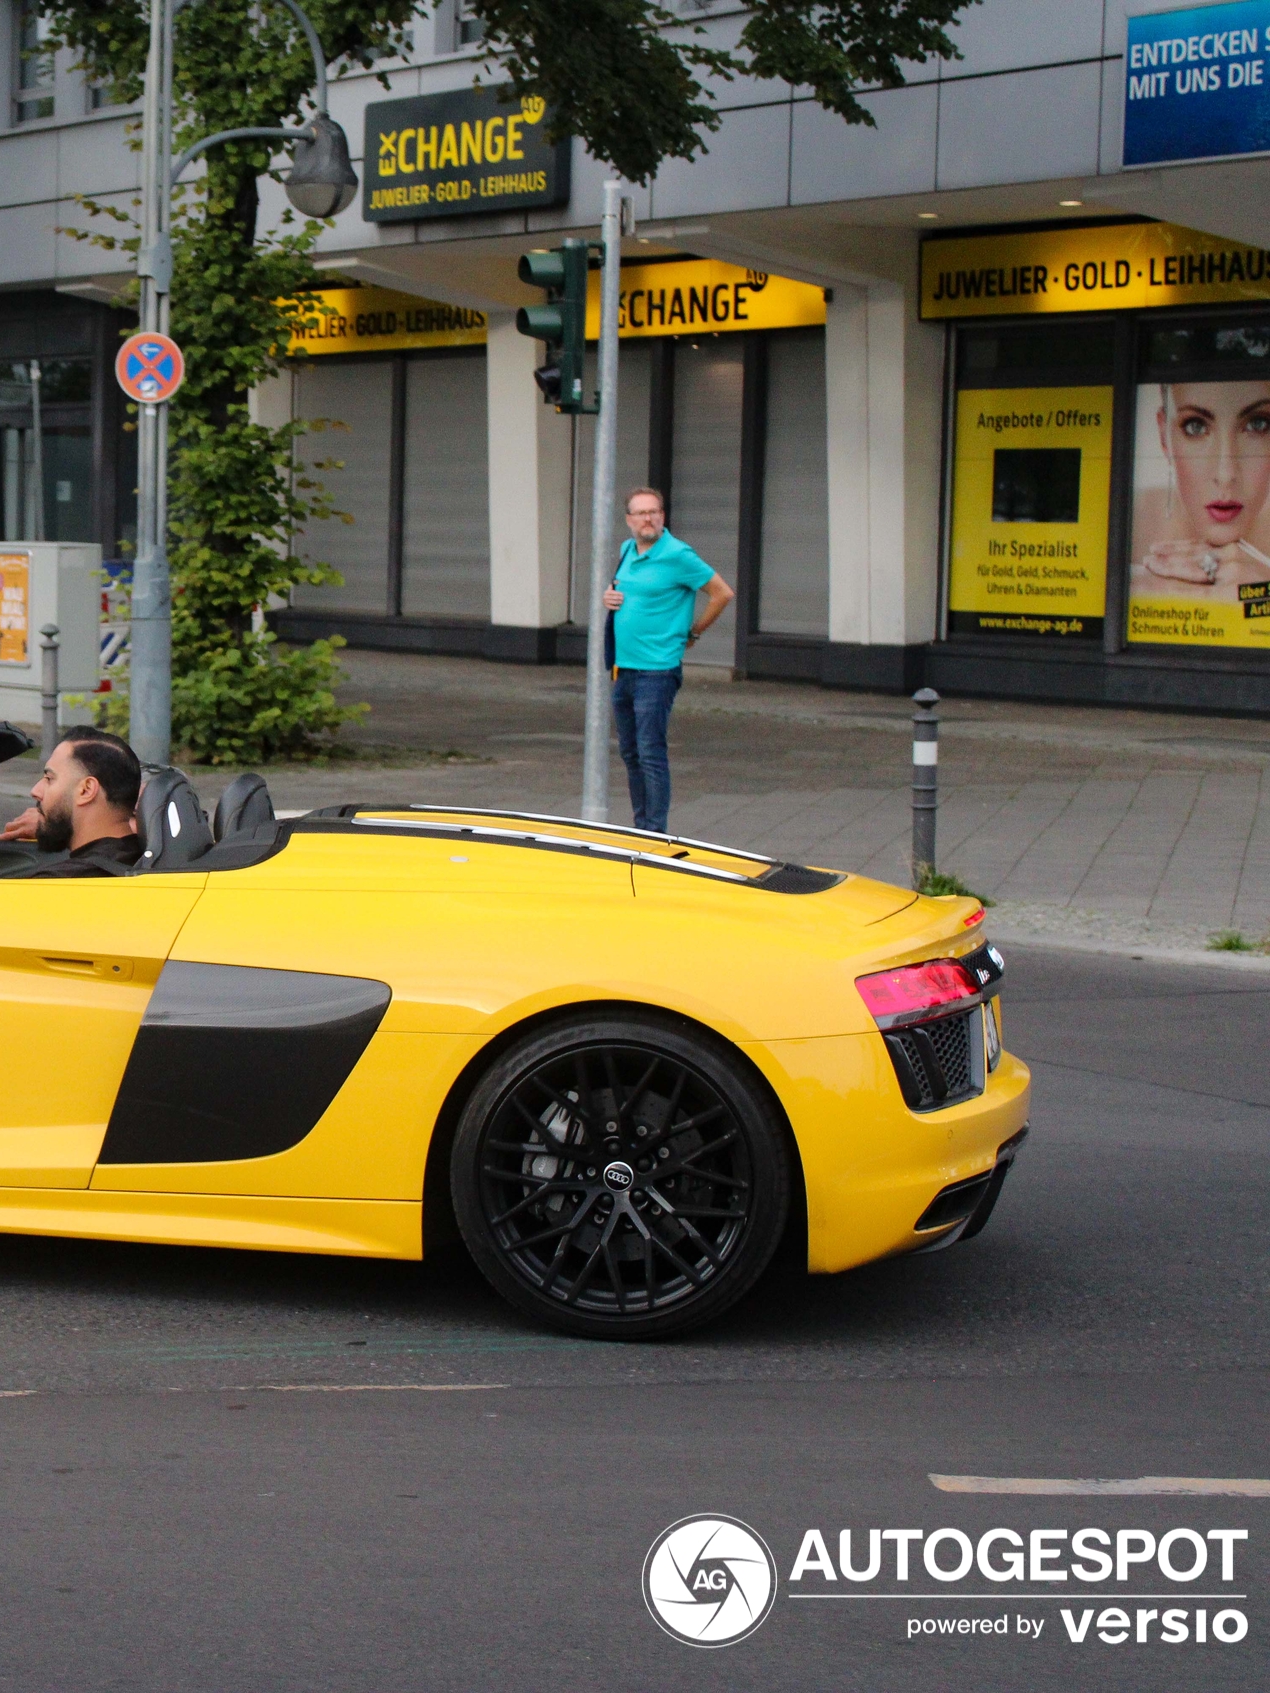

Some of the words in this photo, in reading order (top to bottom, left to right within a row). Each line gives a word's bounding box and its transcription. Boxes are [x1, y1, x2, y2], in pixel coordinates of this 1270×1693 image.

[1130, 28, 1258, 69] ENTDECKEN
[1129, 72, 1170, 100] MIT
[1176, 65, 1221, 95] UNS
[1228, 59, 1264, 88] DIE
[369, 184, 430, 209] JUWELIER
[436, 180, 471, 203] GOLD
[481, 171, 547, 197] LEIHHAUS
[933, 265, 1048, 301] JUWELIER
[1065, 260, 1130, 291] GOLD
[356, 312, 396, 335] GOLD
[406, 306, 485, 333] LEIHHAUS
[977, 411, 1043, 432] Angebote
[1056, 409, 1101, 427] Offers
[988, 540, 1007, 556] Ihr
[1010, 540, 1078, 560] Spezialist
[1025, 584, 1077, 597] Diamanten
[1132, 605, 1191, 622] Onlineshop
[1132, 621, 1178, 636] Schmuck
[1192, 624, 1225, 637] Uhren
